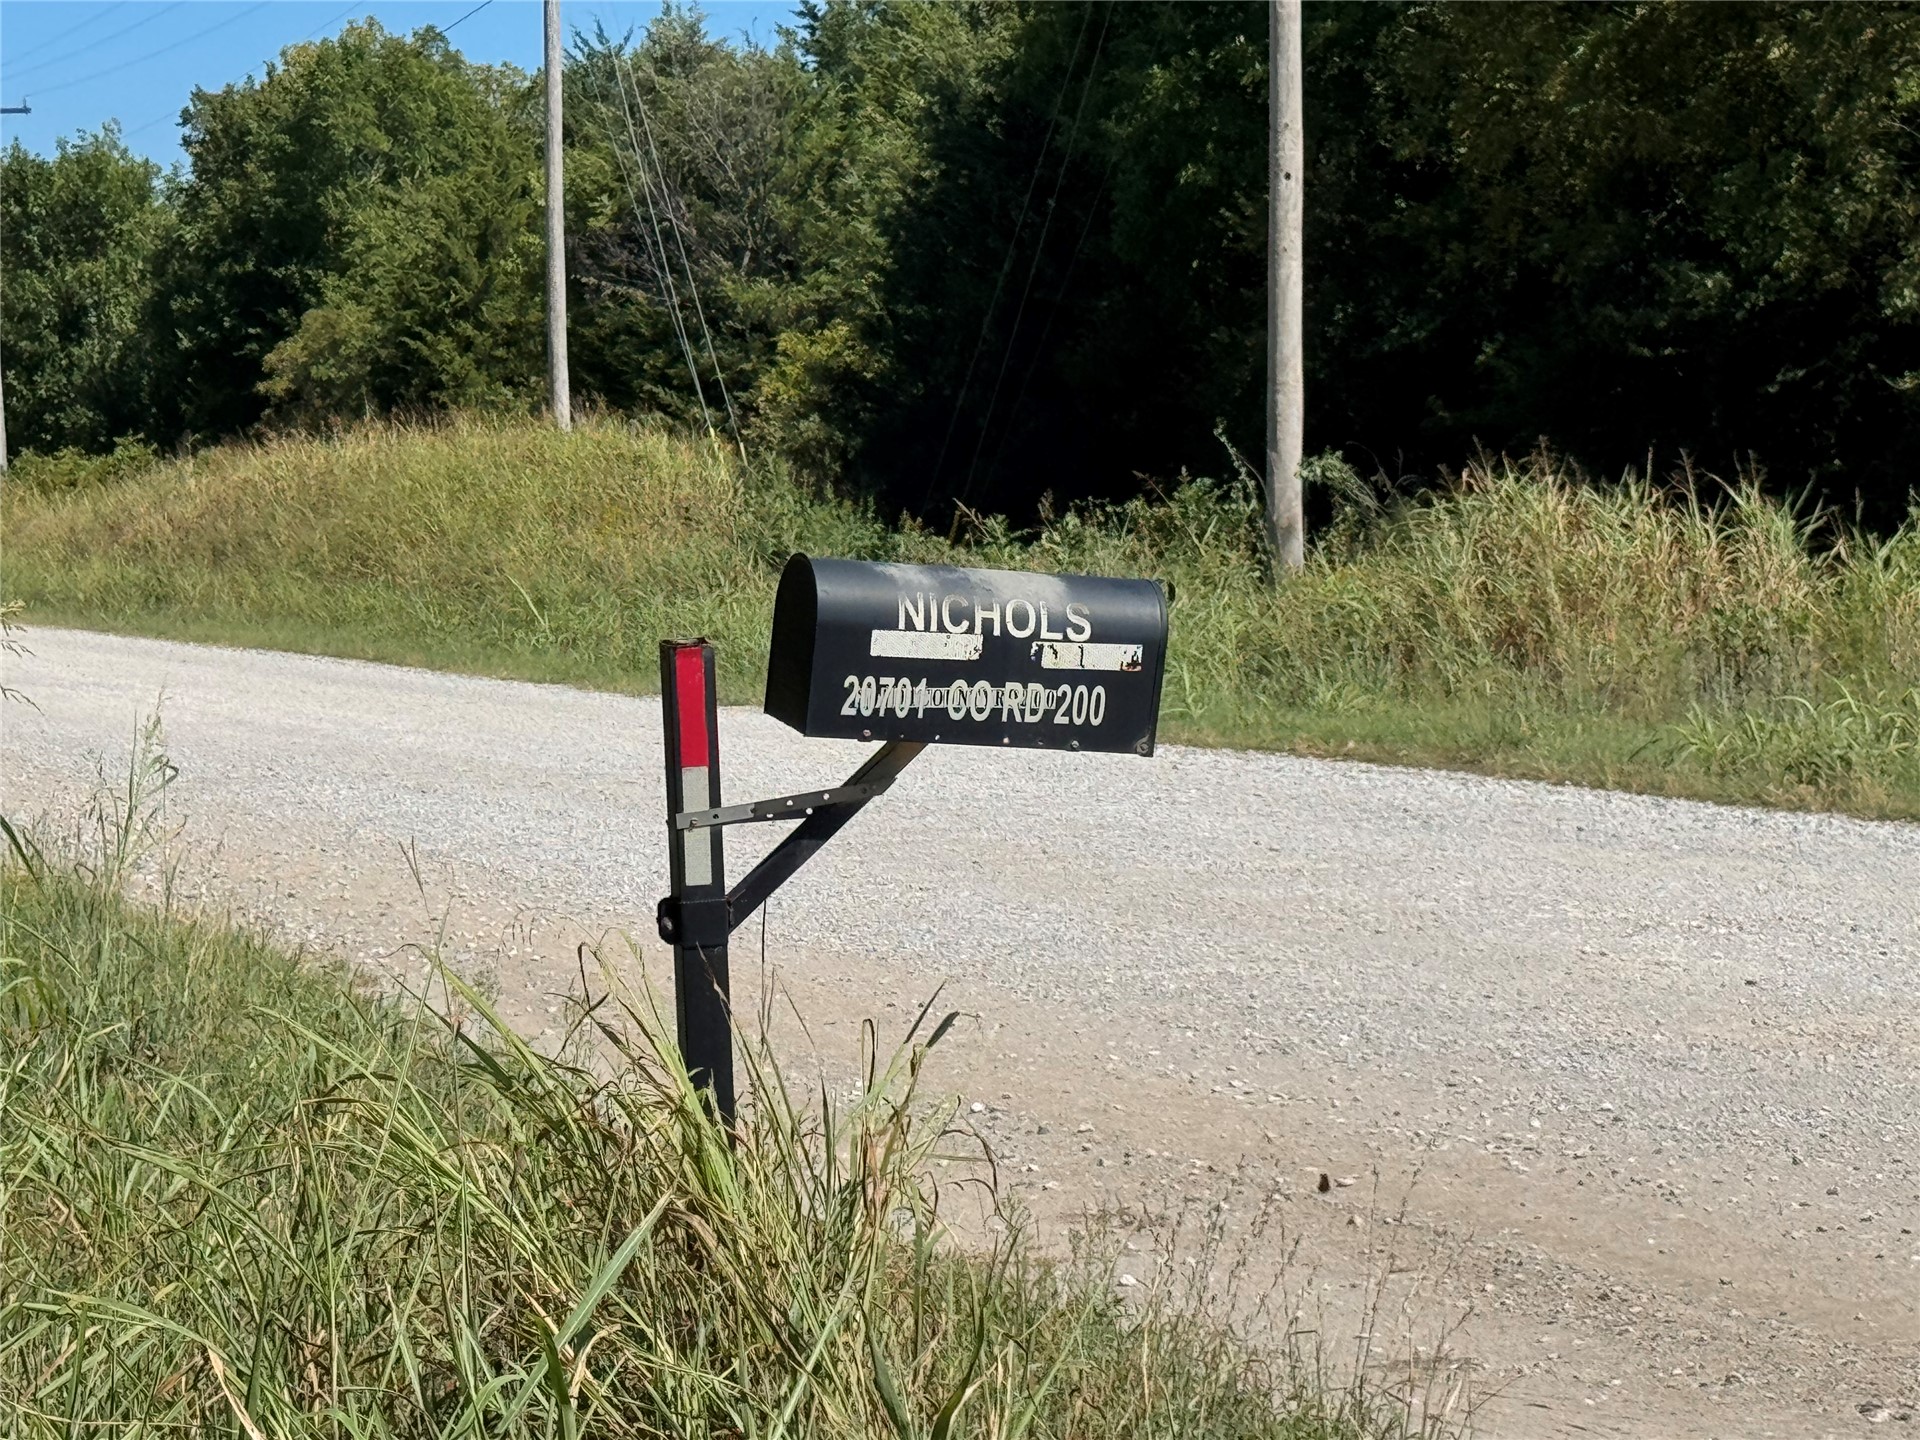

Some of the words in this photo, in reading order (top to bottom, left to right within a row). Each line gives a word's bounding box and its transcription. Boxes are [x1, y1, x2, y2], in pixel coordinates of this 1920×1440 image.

[898, 592, 1092, 642] NICHOLS
[840, 675, 928, 719] 20701
[947, 679, 991, 721] CO
[1001, 681, 1045, 723] RD
[1053, 684, 1106, 726] 200
